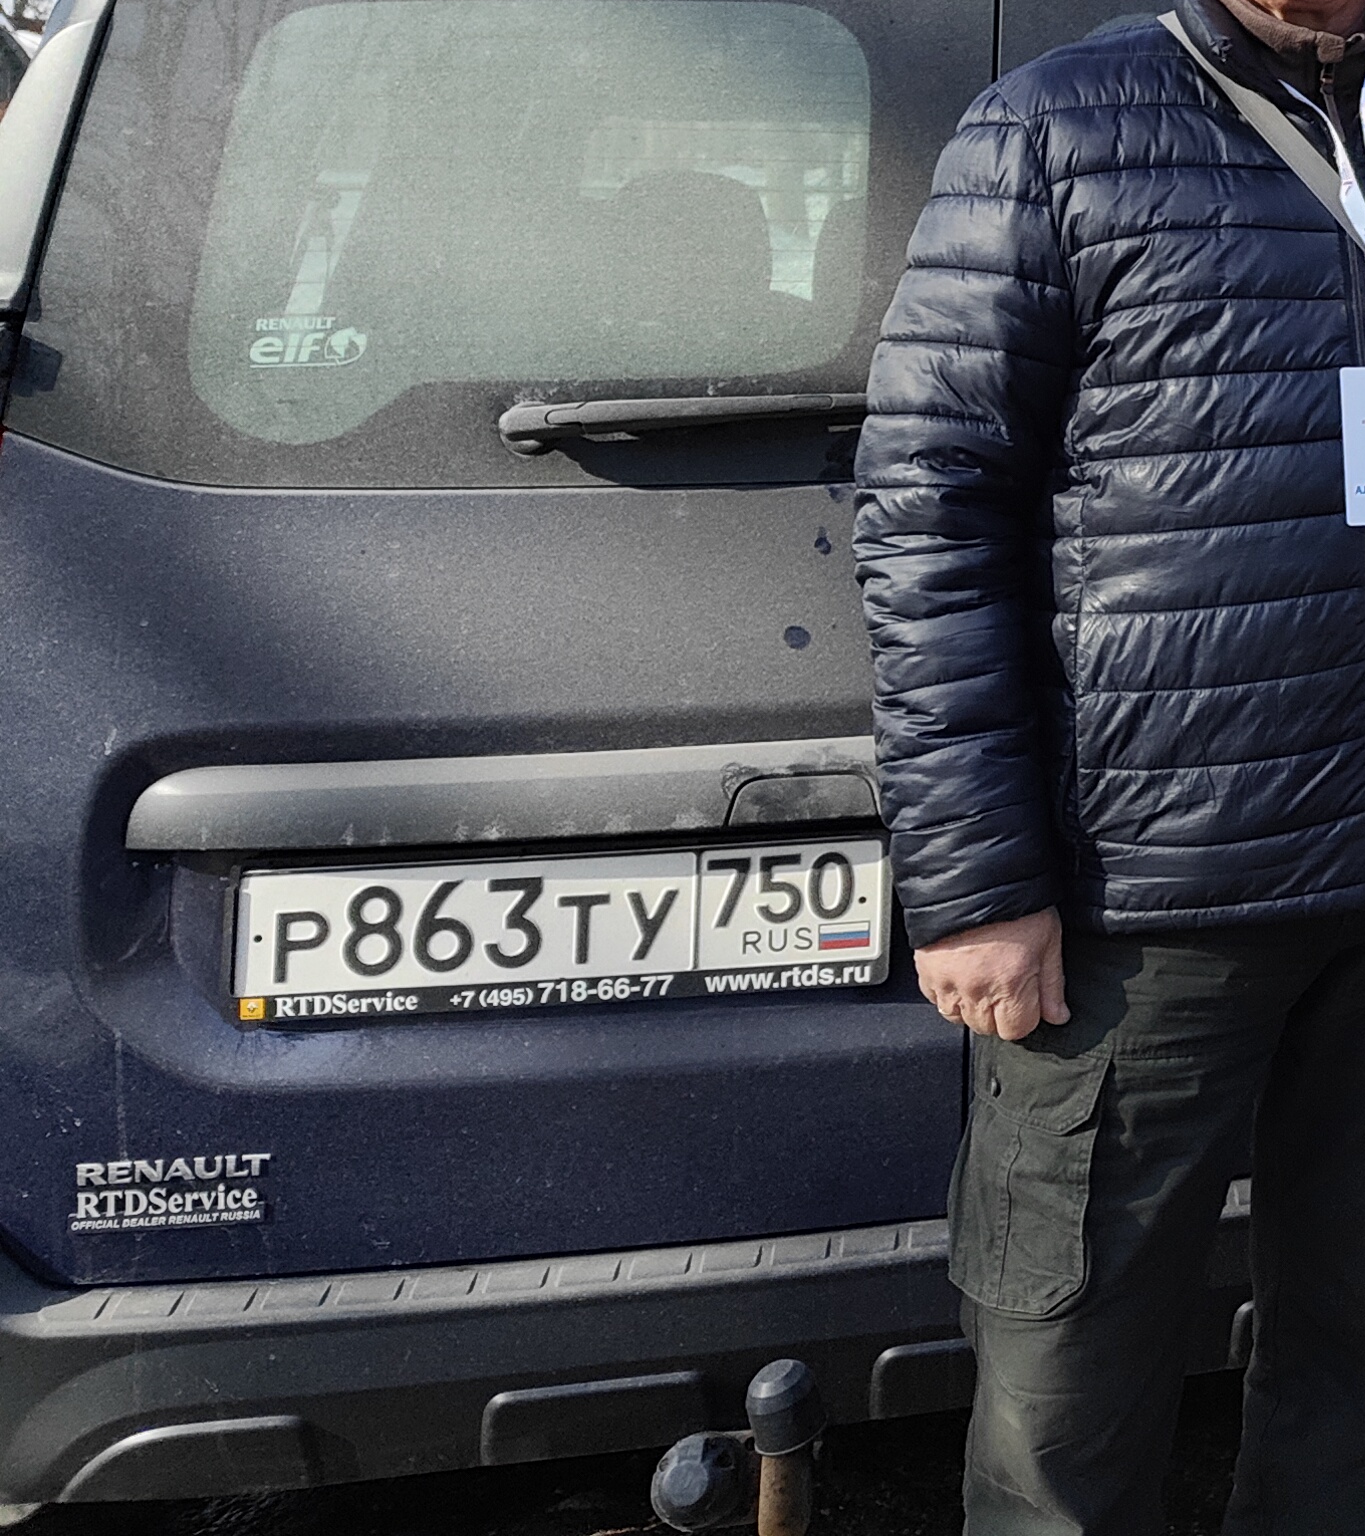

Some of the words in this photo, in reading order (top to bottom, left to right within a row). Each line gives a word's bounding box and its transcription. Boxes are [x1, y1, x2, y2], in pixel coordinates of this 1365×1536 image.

[255, 316, 336, 332] RENAULT
[249, 332, 325, 364] elf
[272, 875, 680, 985] Р863ТУ
[707, 850, 856, 929] 750
[741, 926, 813, 955] RUS
[274, 990, 418, 1018] RTDService
[449, 991, 476, 1008] +7
[479, 986, 534, 1010] (495)
[537, 974, 675, 1005] 718-66-77
[704, 964, 872, 993] www.rtds.ru
[76, 1153, 271, 1187] RENAULT
[76, 1183, 258, 1219] RTDService
[71, 1217, 120, 1231] OFFICIAL
[122, 1216, 167, 1228] DEALER
[168, 1212, 219, 1225] RENAULT
[220, 1209, 261, 1222] RUSSIA
